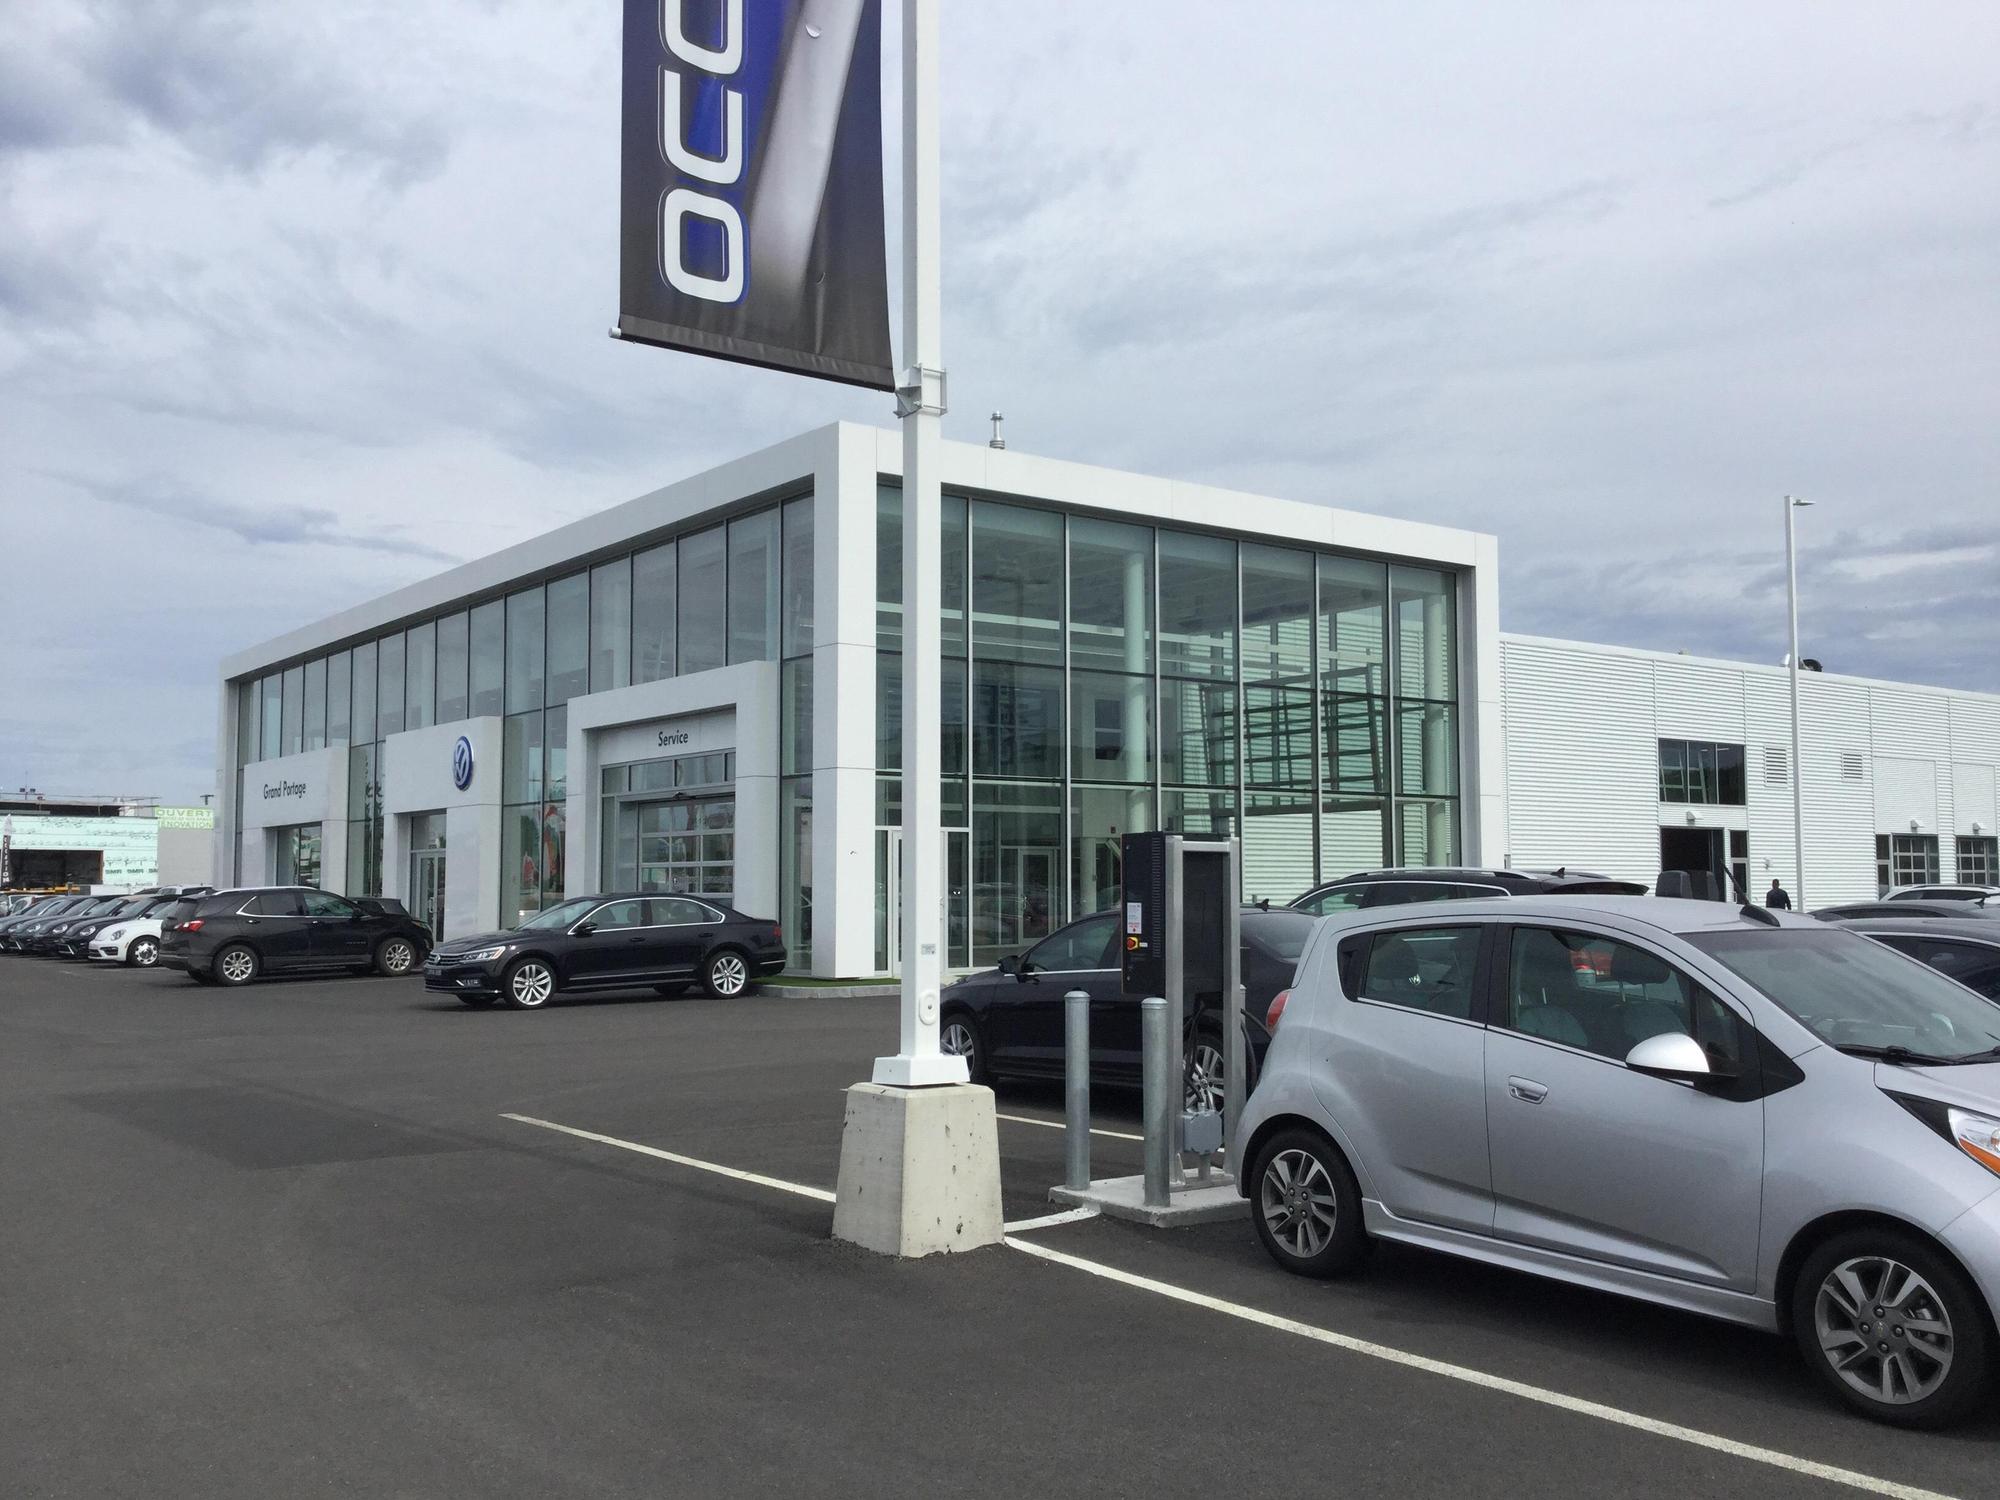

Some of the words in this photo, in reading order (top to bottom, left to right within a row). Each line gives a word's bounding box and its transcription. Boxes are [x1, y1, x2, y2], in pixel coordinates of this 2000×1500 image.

[658, 729, 689, 746] Service
[263, 780, 281, 799] Grand
[282, 780, 306, 799] Portage
[156, 809, 210, 817] OUVERT
